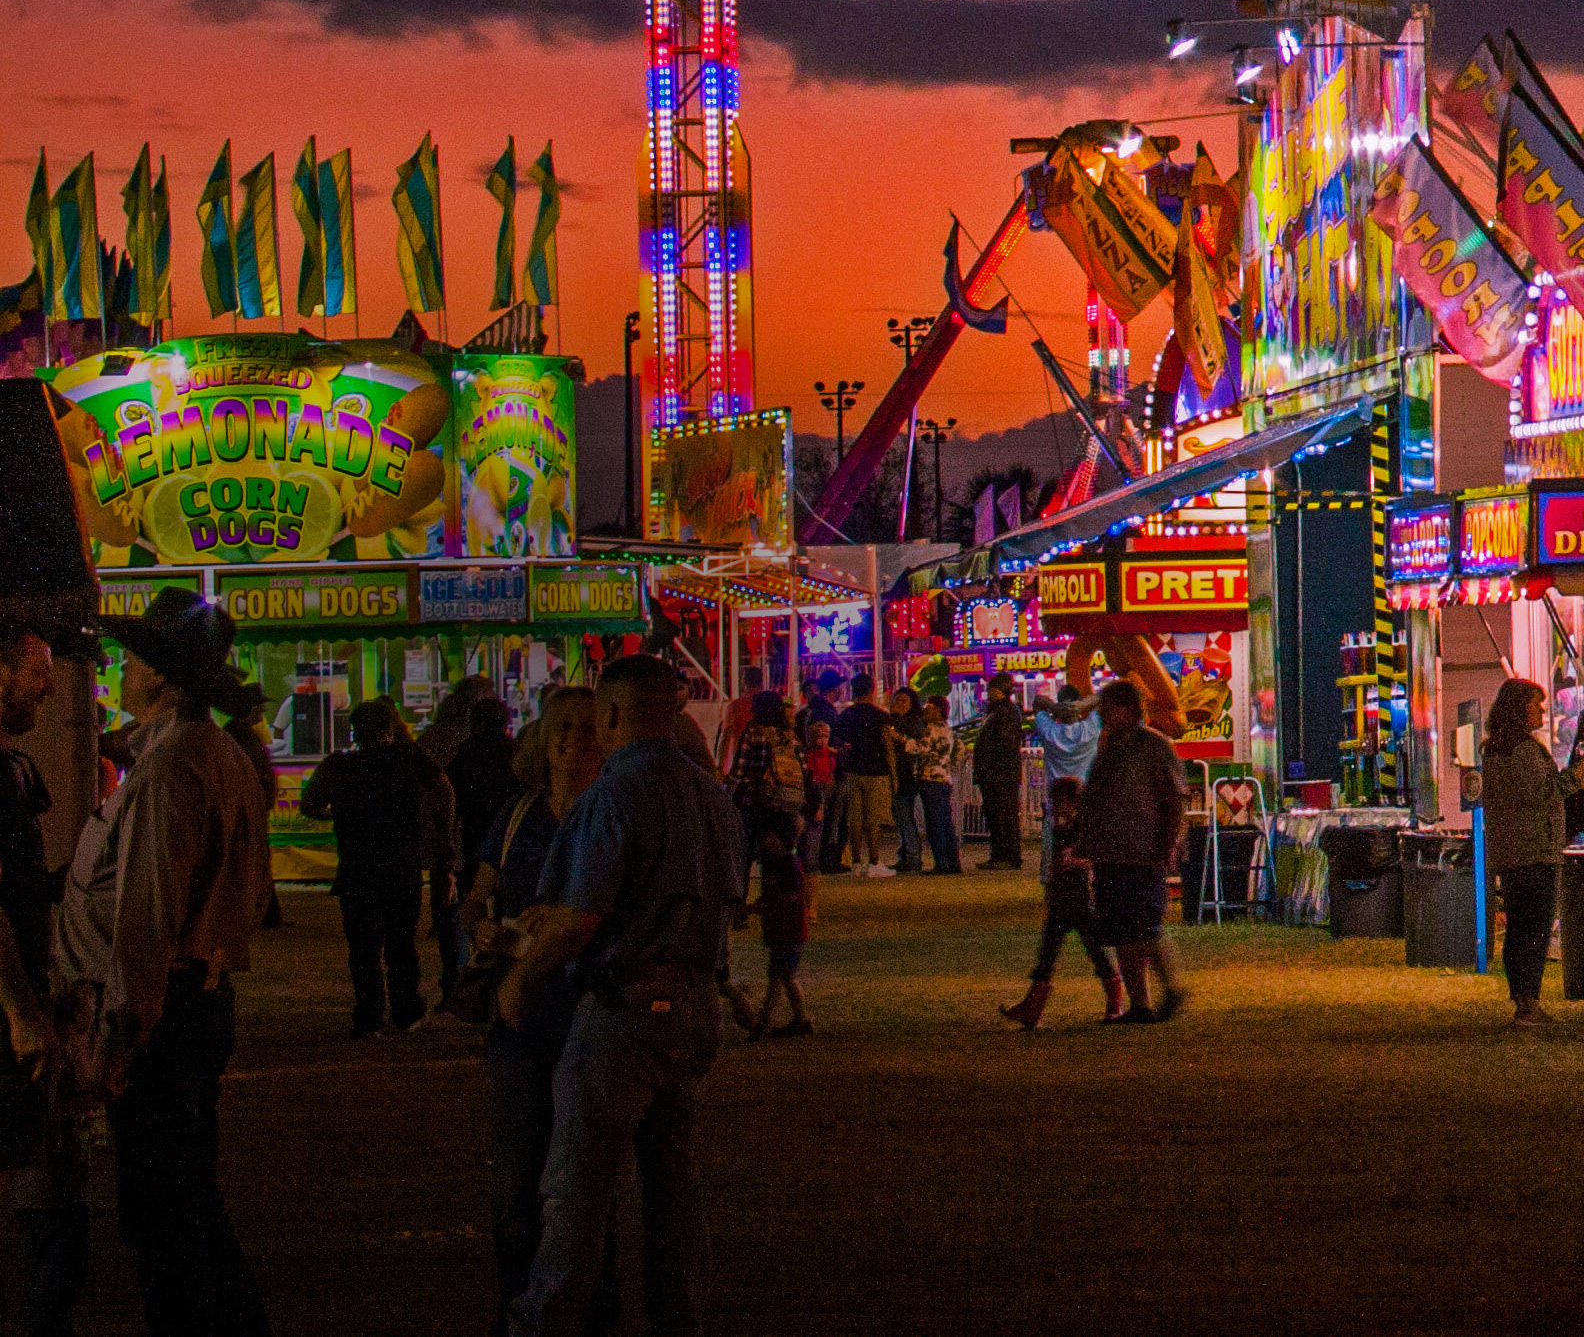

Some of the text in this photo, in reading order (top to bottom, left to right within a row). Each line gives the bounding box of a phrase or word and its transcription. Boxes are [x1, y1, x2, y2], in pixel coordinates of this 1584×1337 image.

[197, 337, 291, 363] FRESH
[177, 363, 312, 395] SQUEEZED
[84, 397, 416, 507] LEMONADE
[180, 476, 311, 517] CORN
[187, 513, 303, 552] DOGS
[423, 572, 461, 601] ICE
[537, 580, 635, 613] CORN DOGS
[1136, 568, 1248, 601] PRET
[228, 583, 400, 621] CORN DOGS
[424, 600, 486, 619] BOTTLED
[996, 652, 1052, 671] FRIED
